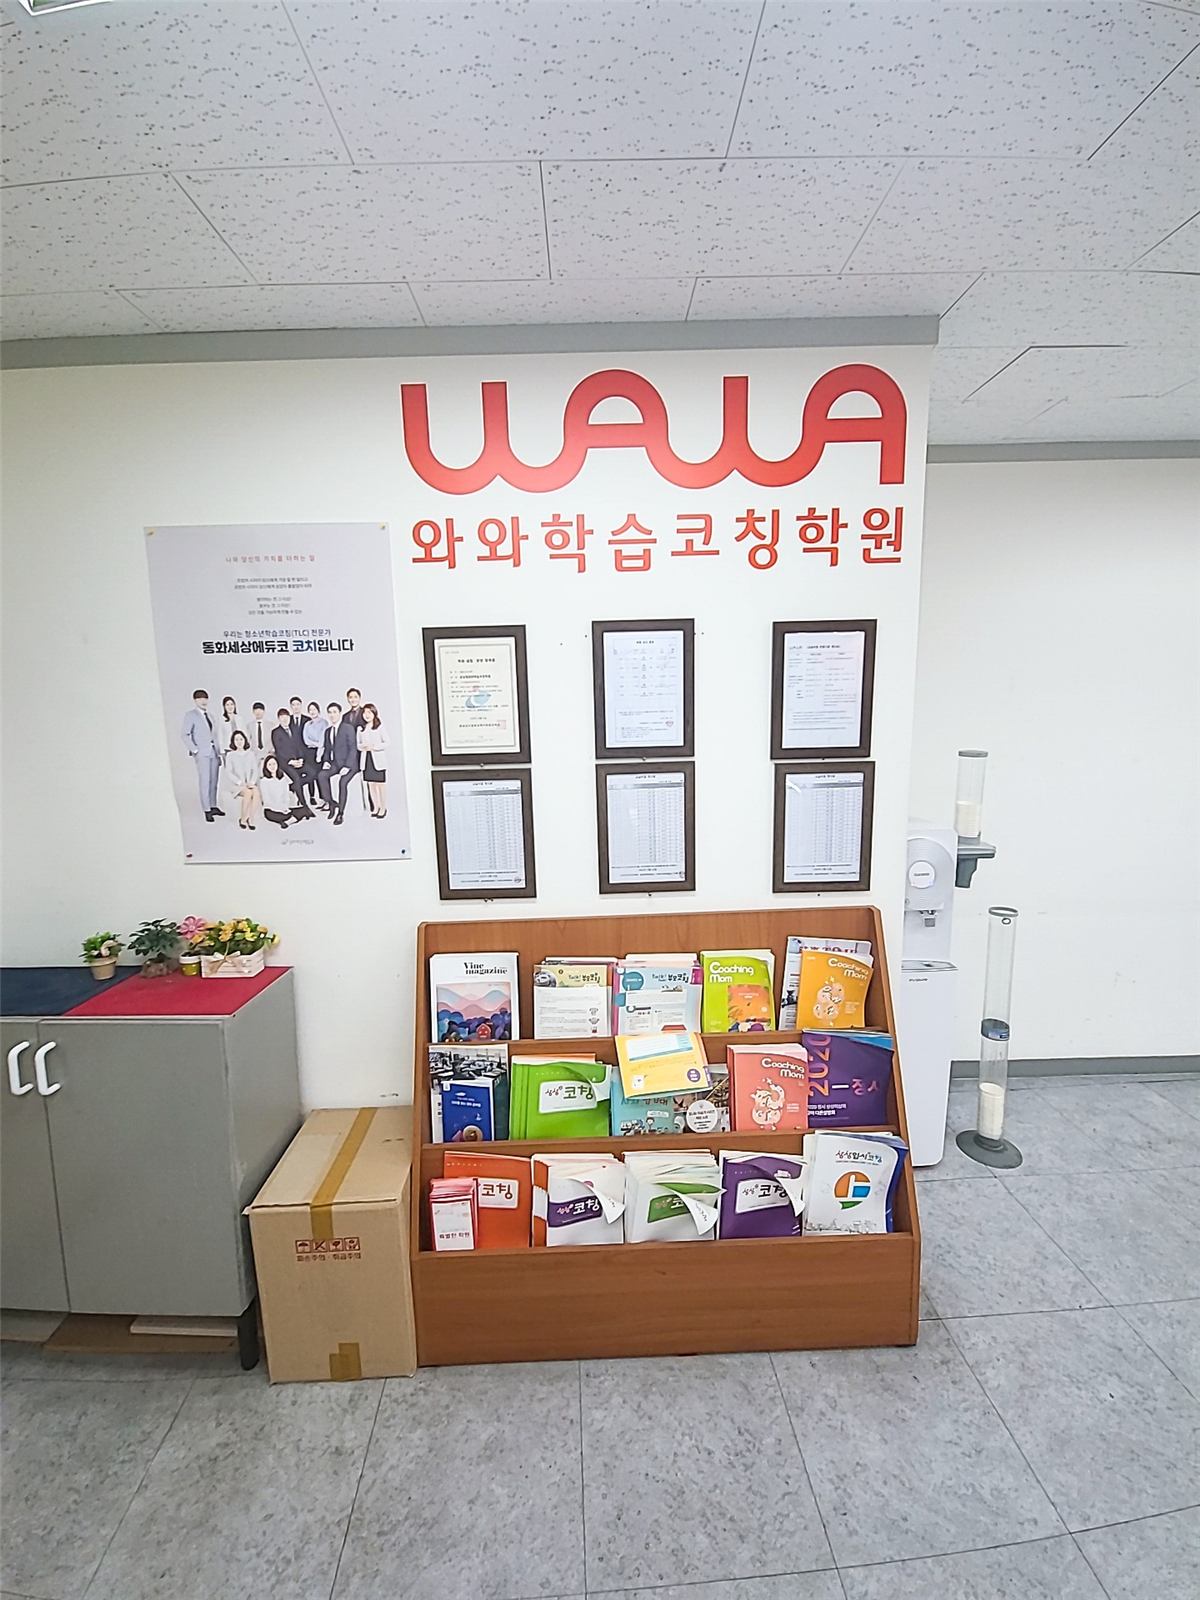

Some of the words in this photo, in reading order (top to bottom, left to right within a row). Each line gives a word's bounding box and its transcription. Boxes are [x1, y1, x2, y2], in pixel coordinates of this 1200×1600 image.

[401, 363, 908, 496] WAWA
[411, 506, 905, 574] 와와학습코칭학원
[223, 630, 243, 639] 우리는
[311, 628, 331, 637] 전문가
[202, 640, 289, 655] 동화세상에듀코
[292, 638, 355, 653] 코치입니다
[465, 967, 508, 976] magazine
[709, 961, 755, 976] Coaching
[828, 957, 869, 976] Coaching
[709, 974, 733, 983] Mom
[844, 968, 868, 981] Mom
[761, 1057, 805, 1073] Coaching
[779, 1069, 805, 1080] Mom
